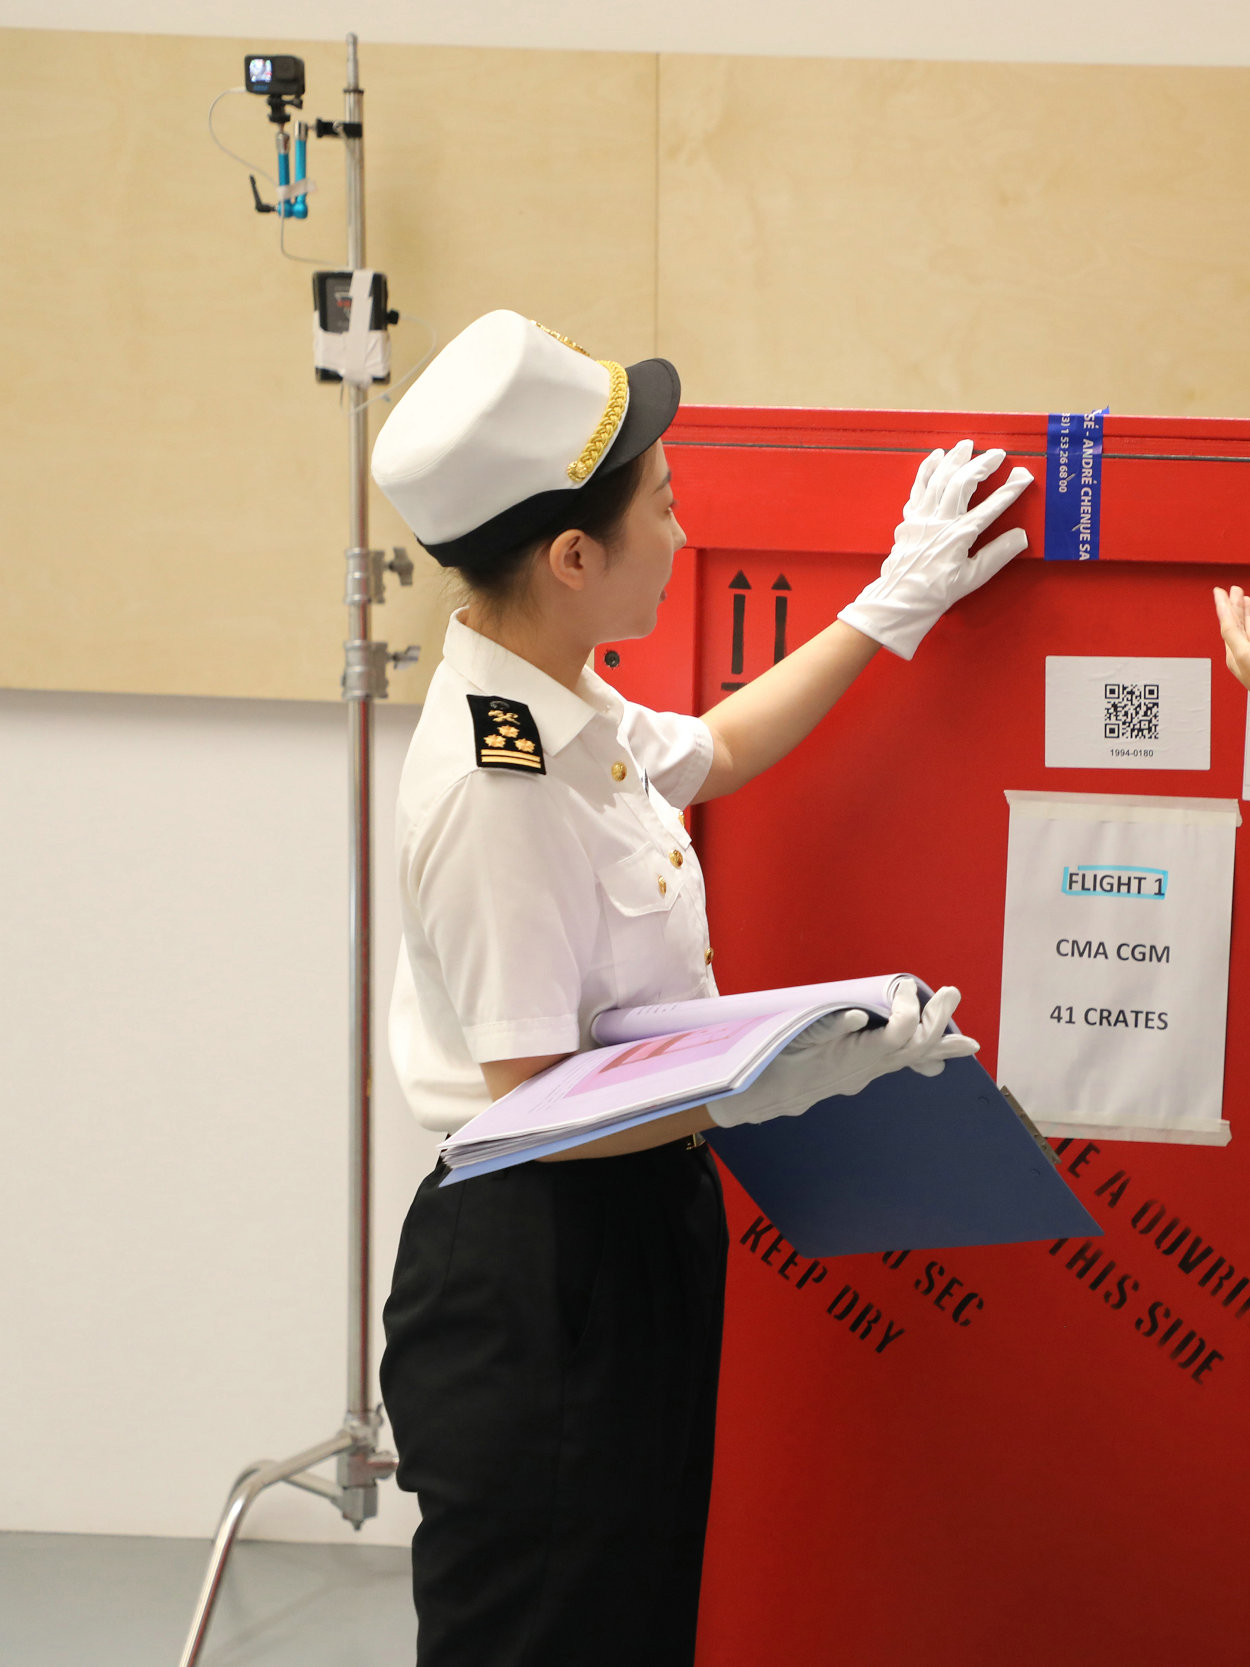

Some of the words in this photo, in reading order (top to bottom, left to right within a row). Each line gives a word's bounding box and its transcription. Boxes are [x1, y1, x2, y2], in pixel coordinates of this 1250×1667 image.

[1060, 437, 1069, 449] 53
[1060, 451, 1069, 464] 26
[1081, 439, 1098, 485] ANDRÉ
[1059, 466, 1068, 478] 68
[1059, 480, 1068, 493] 00
[1080, 488, 1092, 541] CHENUE
[1079, 545, 1091, 561] SA
[1109, 747, 1154, 758] 1994-0180
[1067, 872, 1148, 896] FLIGHT
[1153, 877, 1166, 897] 1
[1055, 938, 1109, 961] CMA
[1116, 941, 1171, 964] CGM
[1049, 1005, 1076, 1025] 41
[1084, 1006, 1169, 1031] CRATES
[1094, 1170, 1131, 1208] A
[739, 1215, 828, 1290] KEEP
[826, 1284, 905, 1354] DRY
[914, 1261, 984, 1327] SEC
[1135, 1301, 1225, 1385] SIDE
